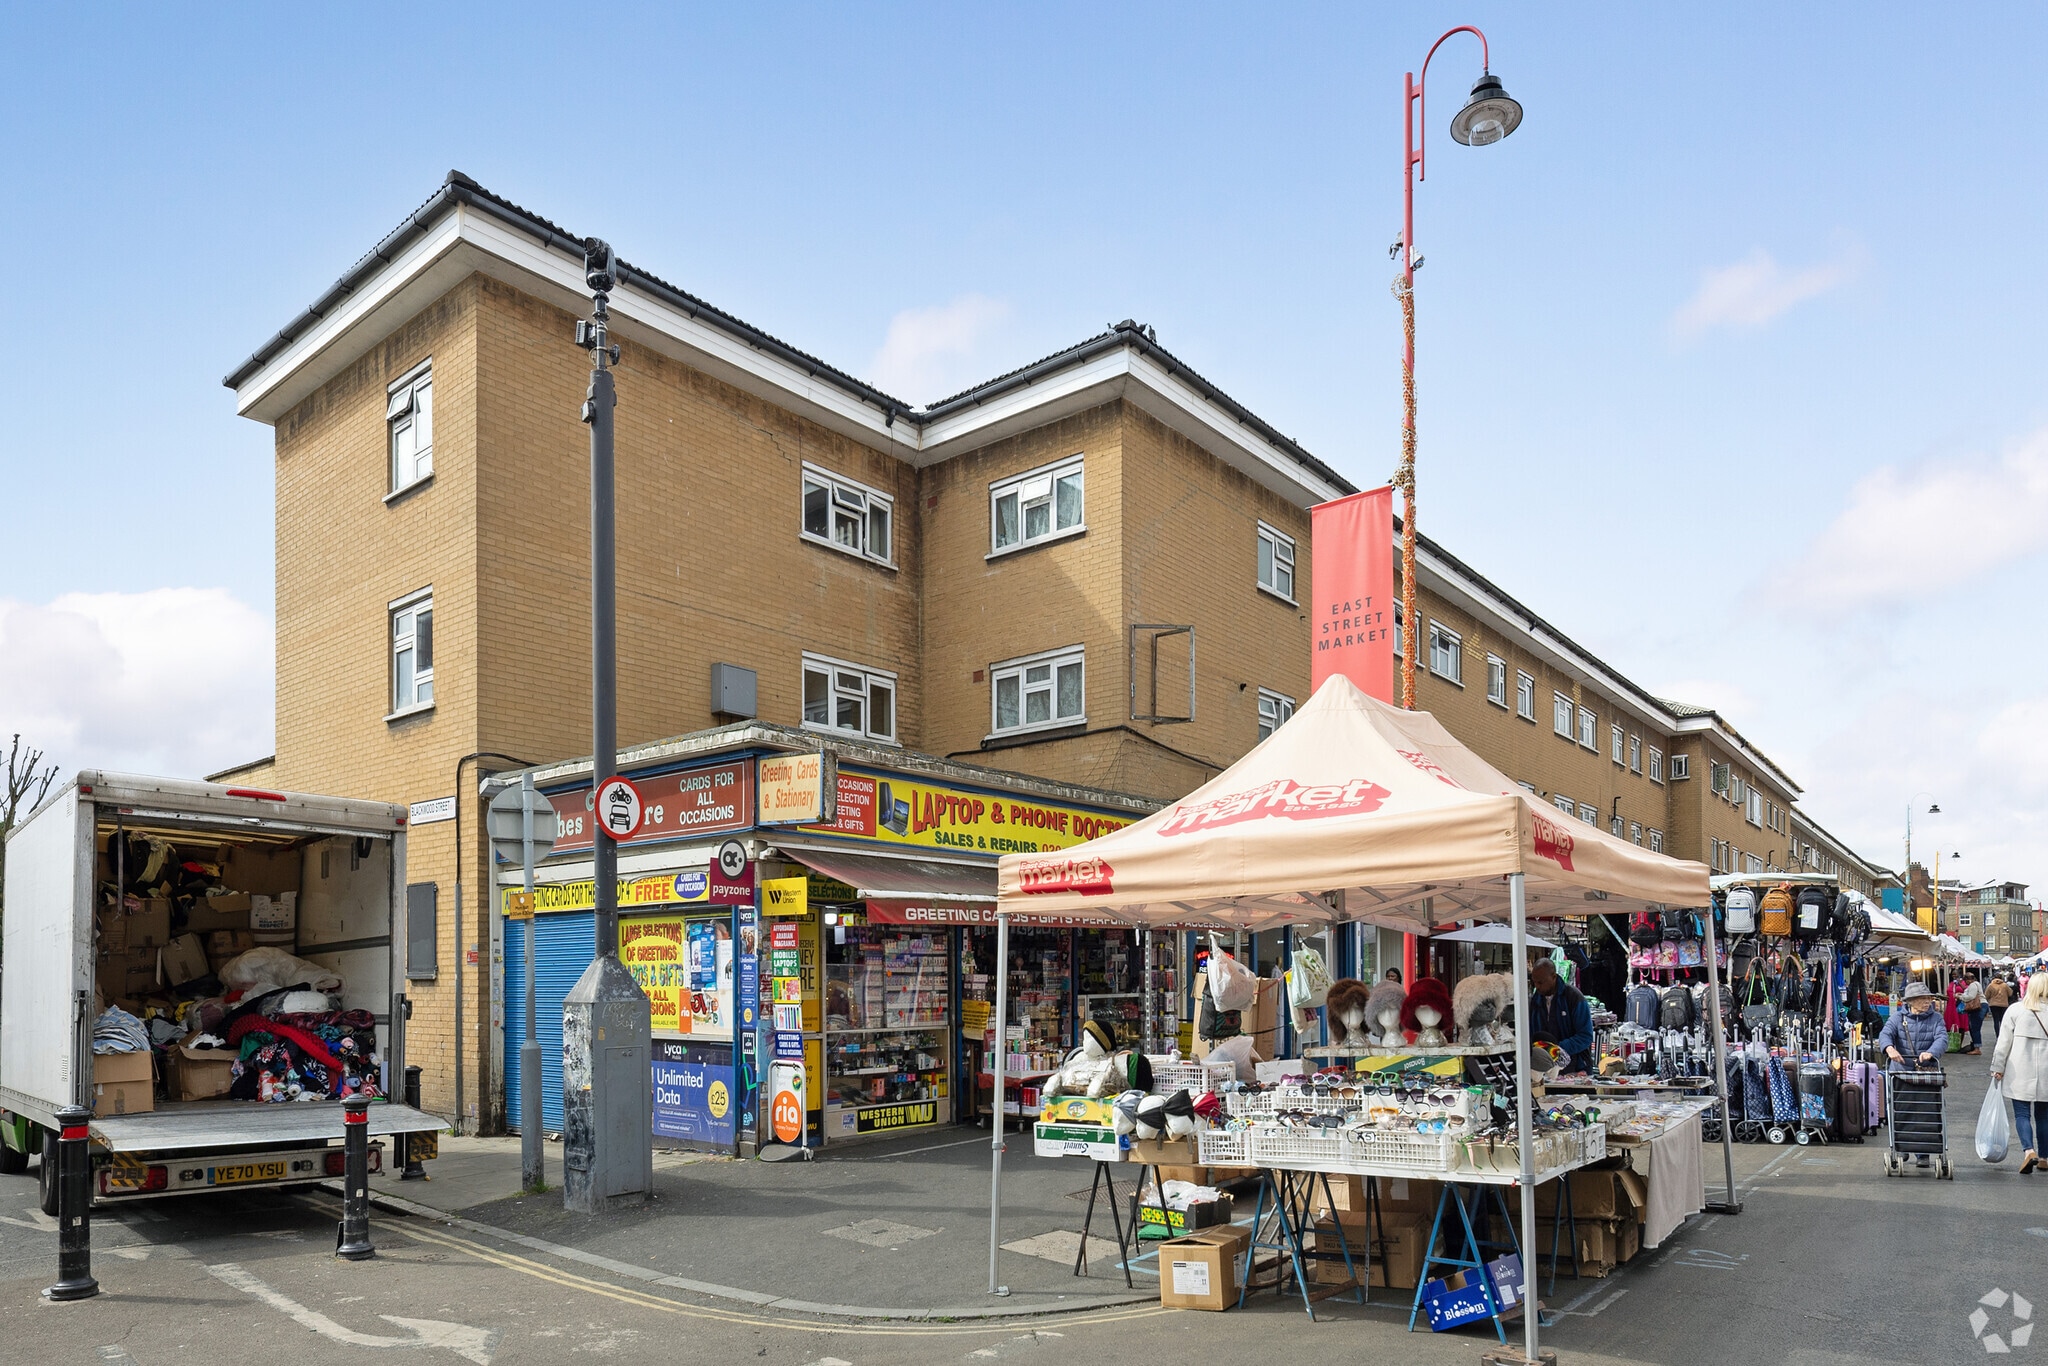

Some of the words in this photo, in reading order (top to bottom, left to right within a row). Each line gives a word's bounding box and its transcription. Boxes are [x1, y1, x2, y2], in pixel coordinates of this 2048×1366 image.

[1332, 596, 1372, 615] EAST
[1322, 612, 1383, 634] STREET
[1318, 628, 1387, 652] MARKET
[761, 762, 793, 786] Greeting
[797, 757, 819, 779] Cards
[679, 775, 711, 793] CARDS
[714, 772, 735, 788] FOR
[837, 778, 874, 793] CCASIONS
[696, 791, 715, 807] ALL
[764, 793, 770, 809] &
[775, 787, 816, 811] Stationary
[837, 791, 870, 806] ELECTION
[1216, 780, 1278, 808] Street
[836, 805, 861, 818] EETING
[912, 789, 985, 833] LAPTOP
[990, 801, 1006, 824] &
[1010, 804, 1069, 833] PHONE
[1158, 779, 1373, 831] market
[1283, 804, 1313, 813] Est.
[1314, 801, 1362, 811] 1880
[679, 804, 735, 826] OCCASIONS
[845, 821, 865, 831] GIFTS
[934, 830, 974, 848] SALES
[977, 837, 987, 849] &
[990, 837, 1038, 853] REPAIRS
[1019, 856, 1105, 887] market
[571, 885, 583, 905] FOR
[635, 882, 671, 902] FREE
[712, 884, 751, 897] payzone
[782, 889, 801, 897] Western
[782, 896, 796, 904] Union
[740, 911, 751, 921] Lyca
[905, 907, 980, 922] GREETING
[621, 925, 642, 947] LARGE
[642, 922, 682, 946] SELECTIONS
[799, 940, 815, 949] ECEIVE
[626, 947, 636, 962] OF
[636, 945, 678, 962] GREETINGS
[773, 951, 798, 959] MOBILES
[773, 959, 798, 967] LAPTOPS
[659, 963, 684, 987] GIFTS
[653, 989, 669, 1002] ALL
[650, 1001, 676, 1016] SIONS
[680, 1007, 690, 1017] ria
[777, 1033, 800, 1041] GREETING
[664, 1042, 682, 1056] Lyca
[656, 1067, 704, 1088] Unlimited
[656, 1087, 681, 1105] Data
[711, 1091, 726, 1106] £25
[775, 1096, 798, 1125] ria
[860, 1106, 905, 1121] WESTERN
[873, 1115, 905, 1128] UNION
[217, 1165, 254, 1181] YE70
[258, 1162, 285, 1177] YSU
[1444, 1301, 1486, 1321] Blossom
